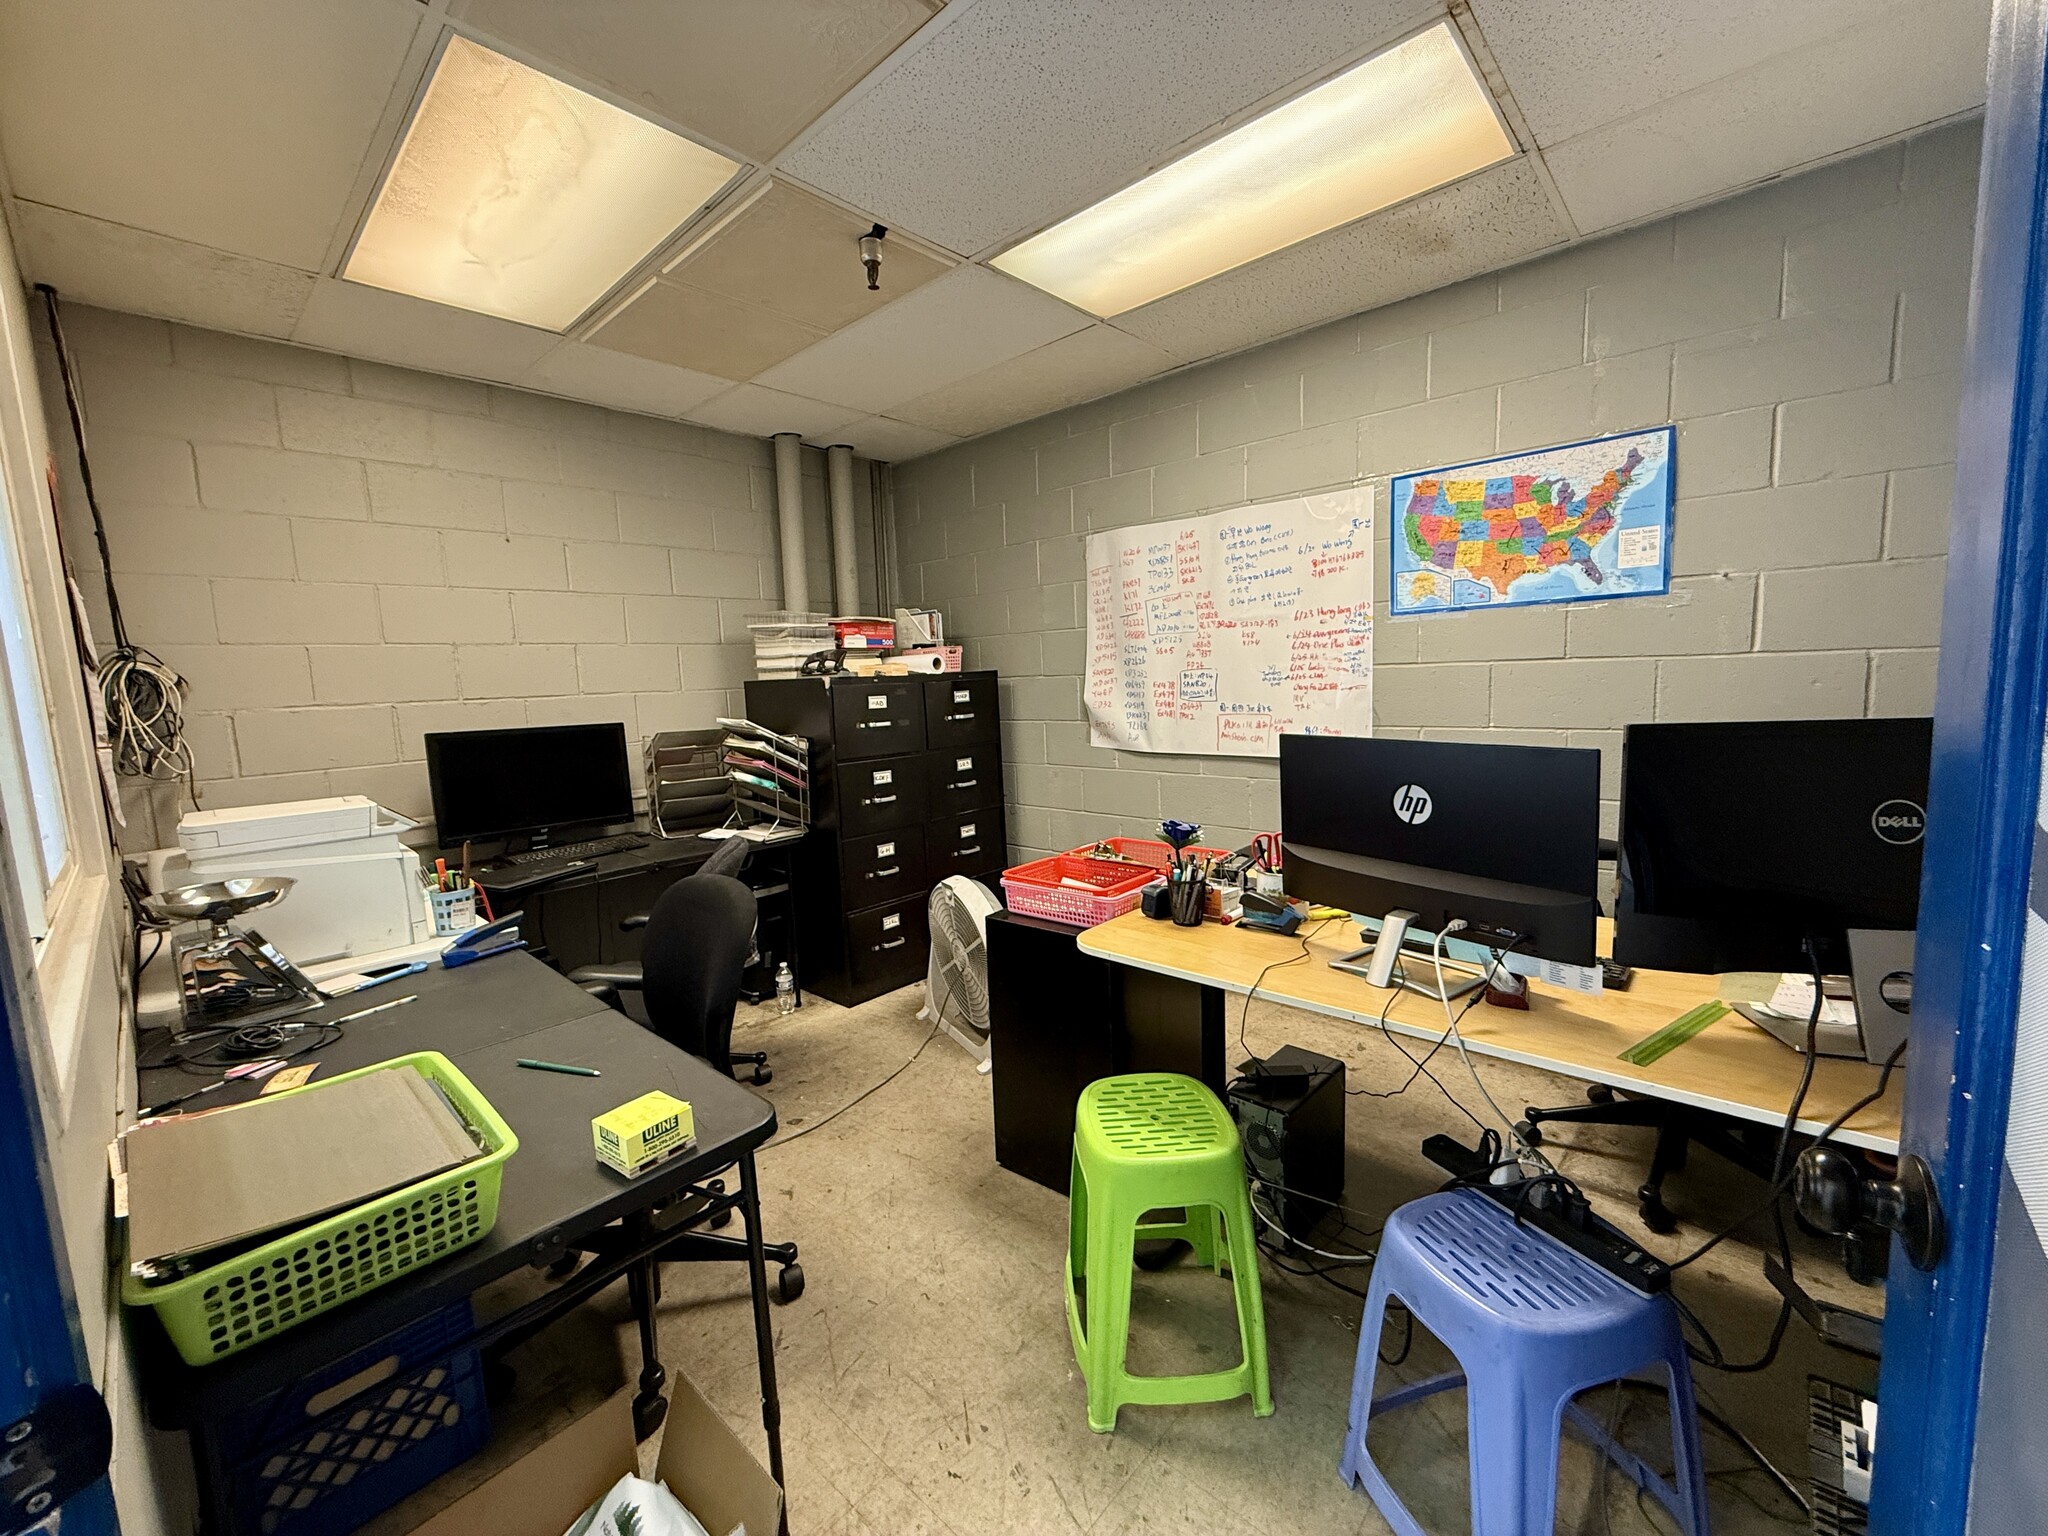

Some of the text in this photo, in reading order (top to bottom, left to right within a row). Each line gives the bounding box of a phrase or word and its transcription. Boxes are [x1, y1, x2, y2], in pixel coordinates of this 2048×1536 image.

[1294, 609, 1315, 622] 6/23
[1398, 784, 1428, 824] hp
[1878, 816, 1922, 828] DELL
[644, 1115, 678, 1140] ULINE
